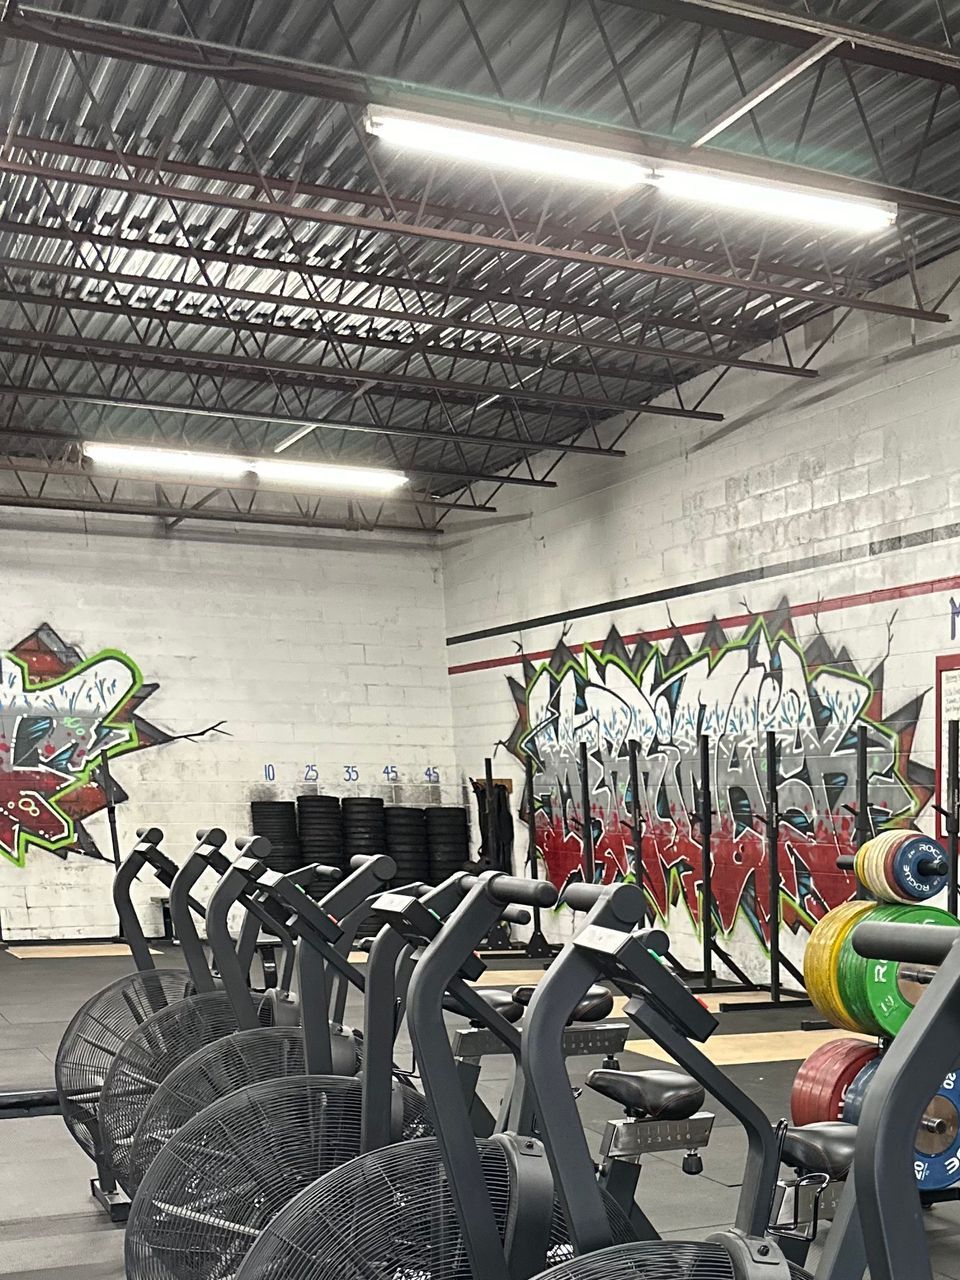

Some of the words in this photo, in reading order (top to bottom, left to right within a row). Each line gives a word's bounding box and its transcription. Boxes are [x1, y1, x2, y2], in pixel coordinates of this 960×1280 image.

[264, 763, 275, 781] 10
[304, 764, 319, 781] 25
[343, 765, 359, 782] 35
[382, 765, 398, 782] 45
[424, 766, 440, 783] 45
[903, 864, 930, 891] ROGUE
[943, 1072, 957, 1090] 20
